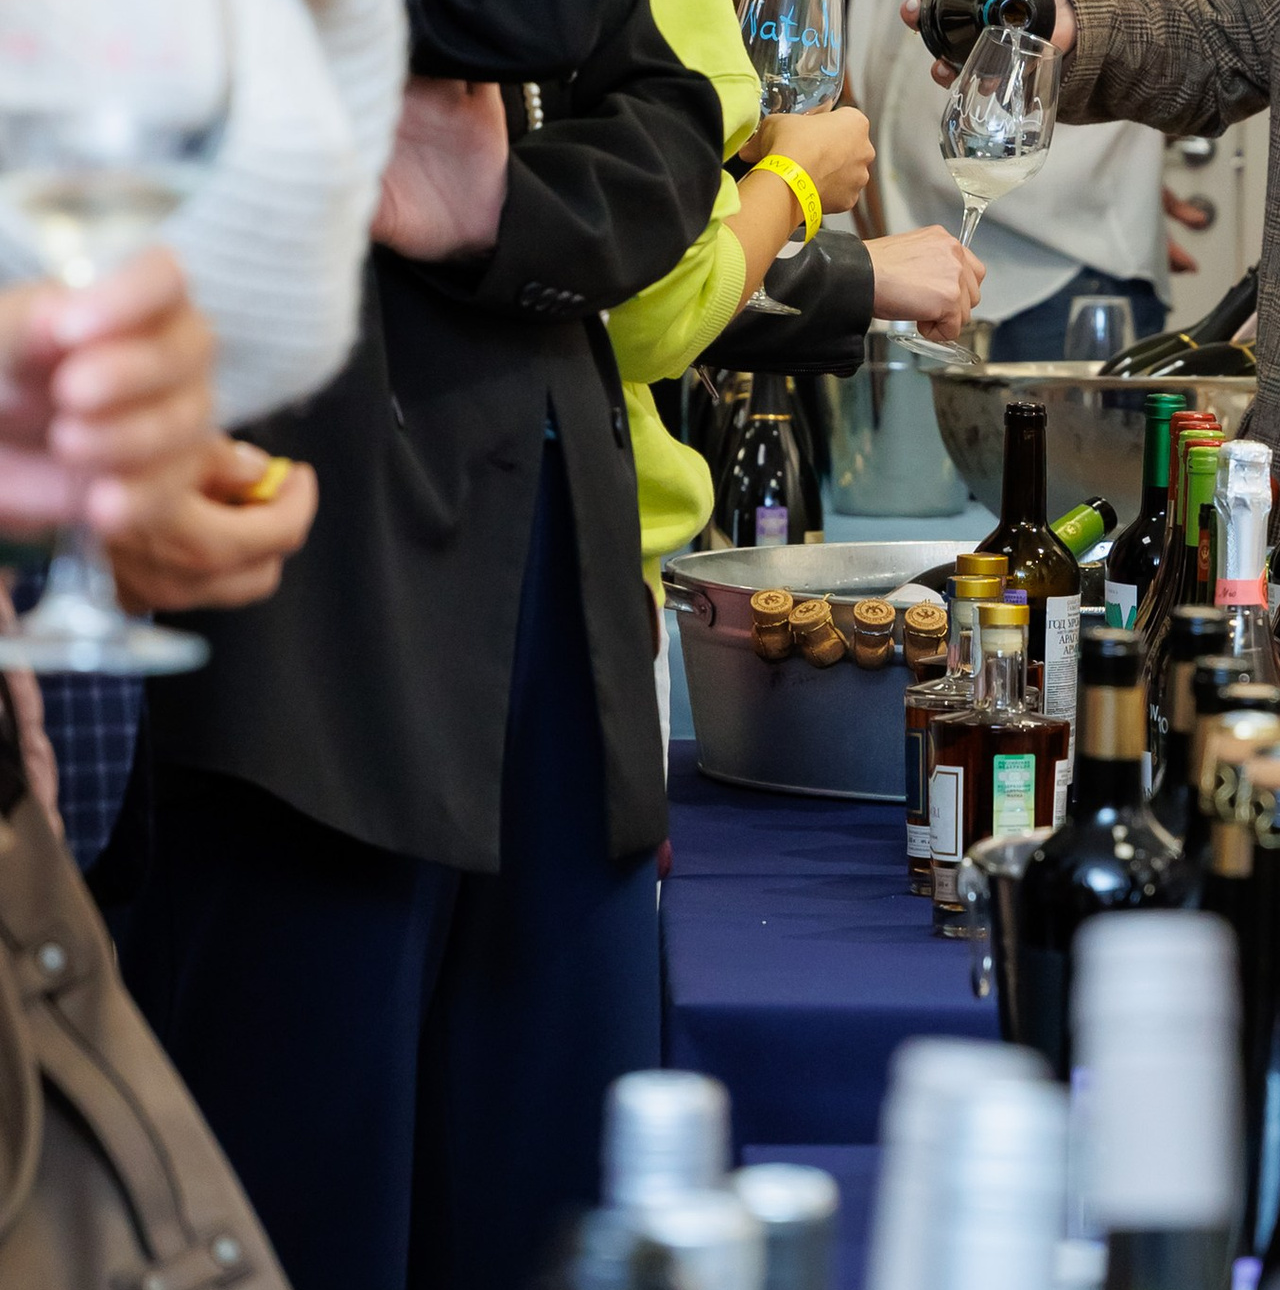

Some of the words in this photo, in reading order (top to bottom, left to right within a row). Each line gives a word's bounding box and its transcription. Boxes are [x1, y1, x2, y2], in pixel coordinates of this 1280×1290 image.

[741, 0, 841, 77] Nataly
[769, 159, 807, 191] wine
[805, 193, 819, 228] fest
